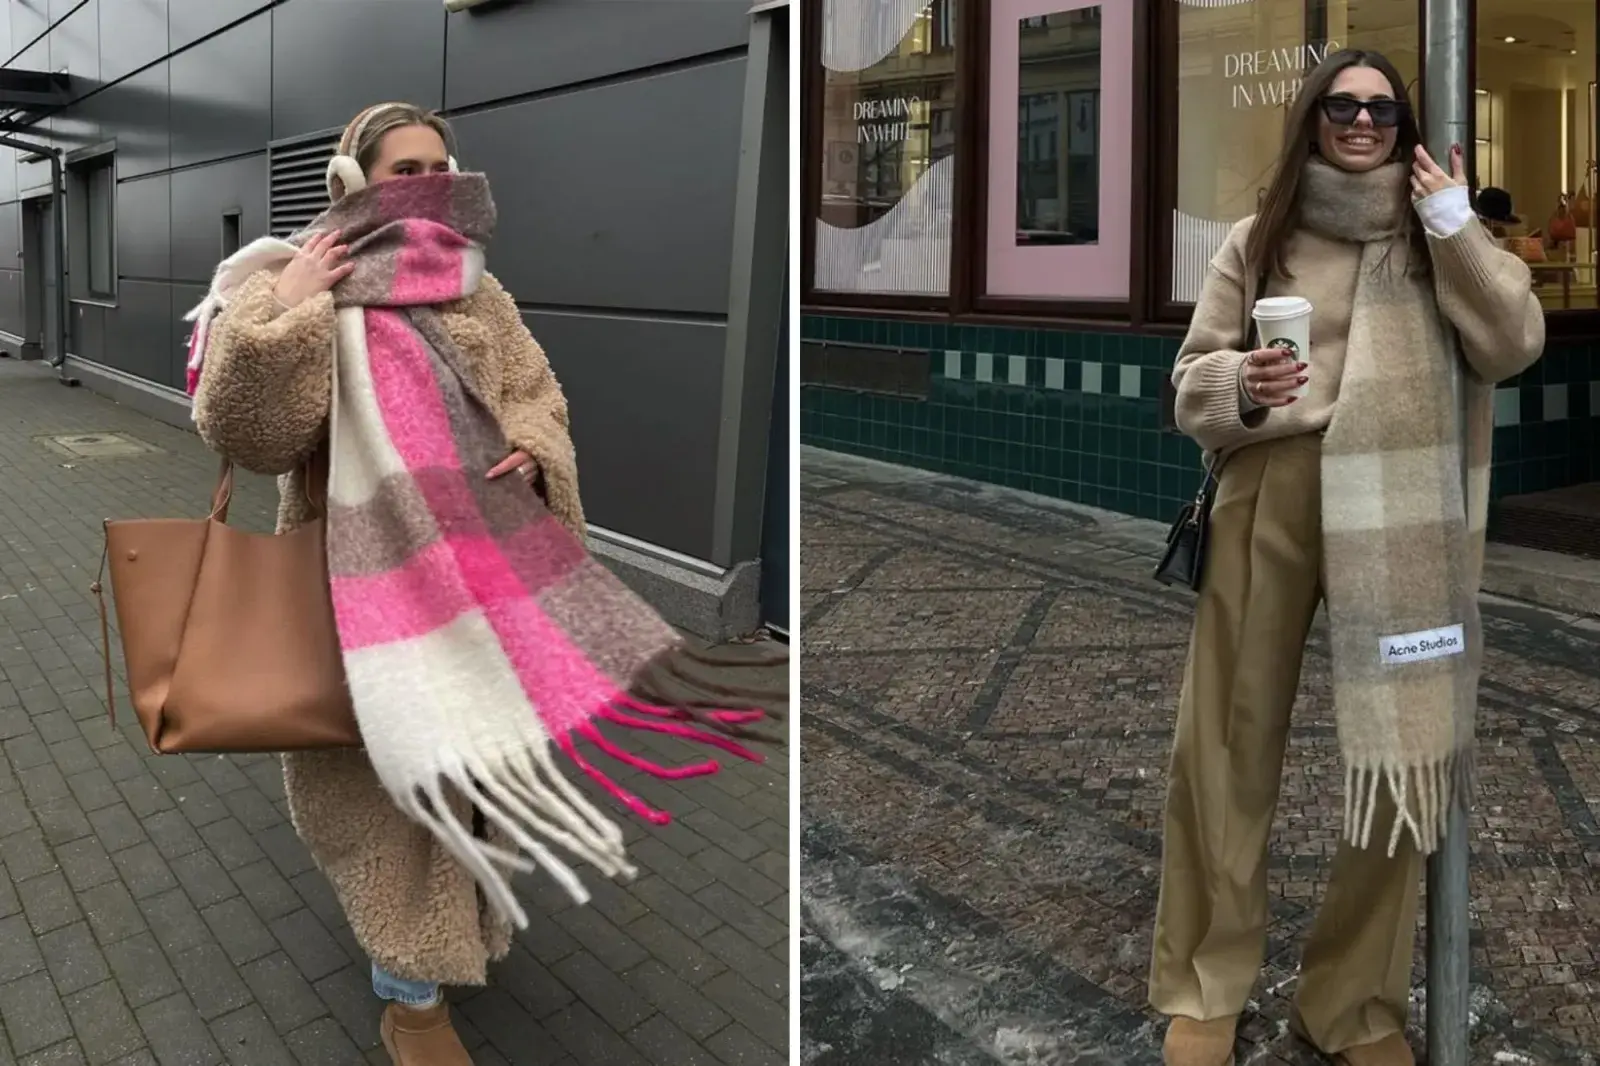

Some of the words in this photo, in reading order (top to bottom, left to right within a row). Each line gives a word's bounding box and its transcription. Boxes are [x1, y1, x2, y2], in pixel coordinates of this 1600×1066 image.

[1232, 83, 1253, 108] IN
[857, 125, 870, 144] IN
[872, 121, 912, 142] WHITE
[1388, 644, 1418, 656] Acne
[1419, 636, 1458, 652] Studios
